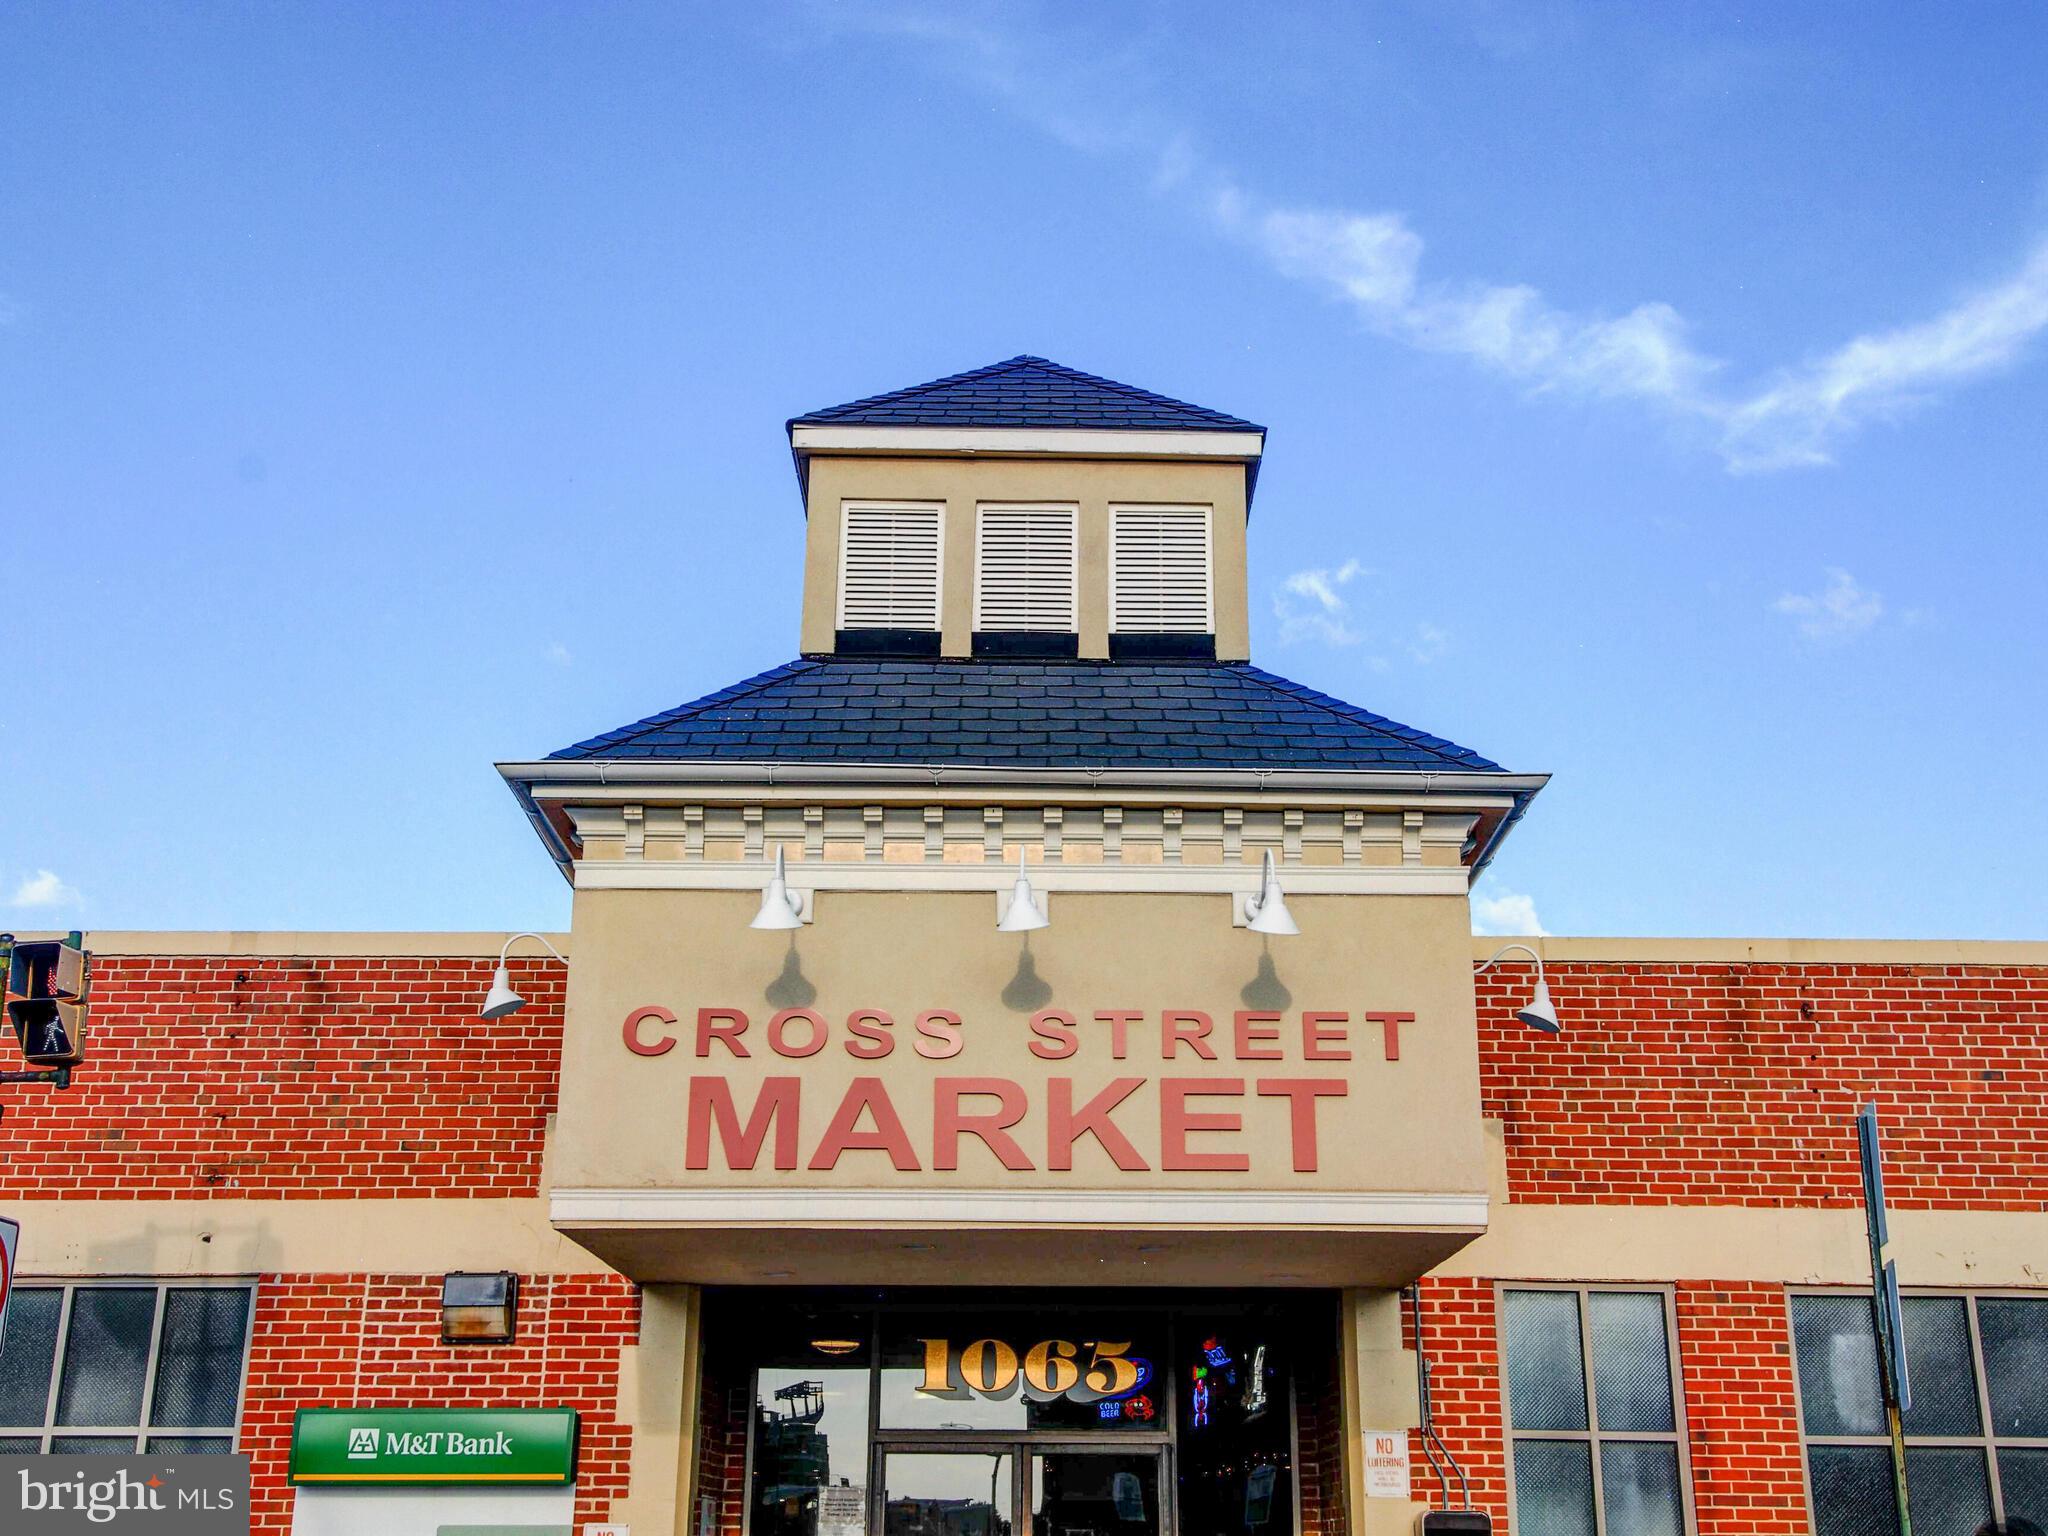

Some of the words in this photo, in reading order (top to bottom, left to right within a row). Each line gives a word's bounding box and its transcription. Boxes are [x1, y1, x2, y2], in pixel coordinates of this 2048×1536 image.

[622, 1006, 965, 1060] CROSS
[1028, 1009, 1416, 1061] STREET
[685, 1076, 1348, 1173] MARKET
[915, 1339, 1138, 1393] 1065
[1101, 1410, 1120, 1418] BEER
[385, 1432, 443, 1455] M&T
[446, 1431, 513, 1455] Bank
[1376, 1437, 1393, 1454] NO
